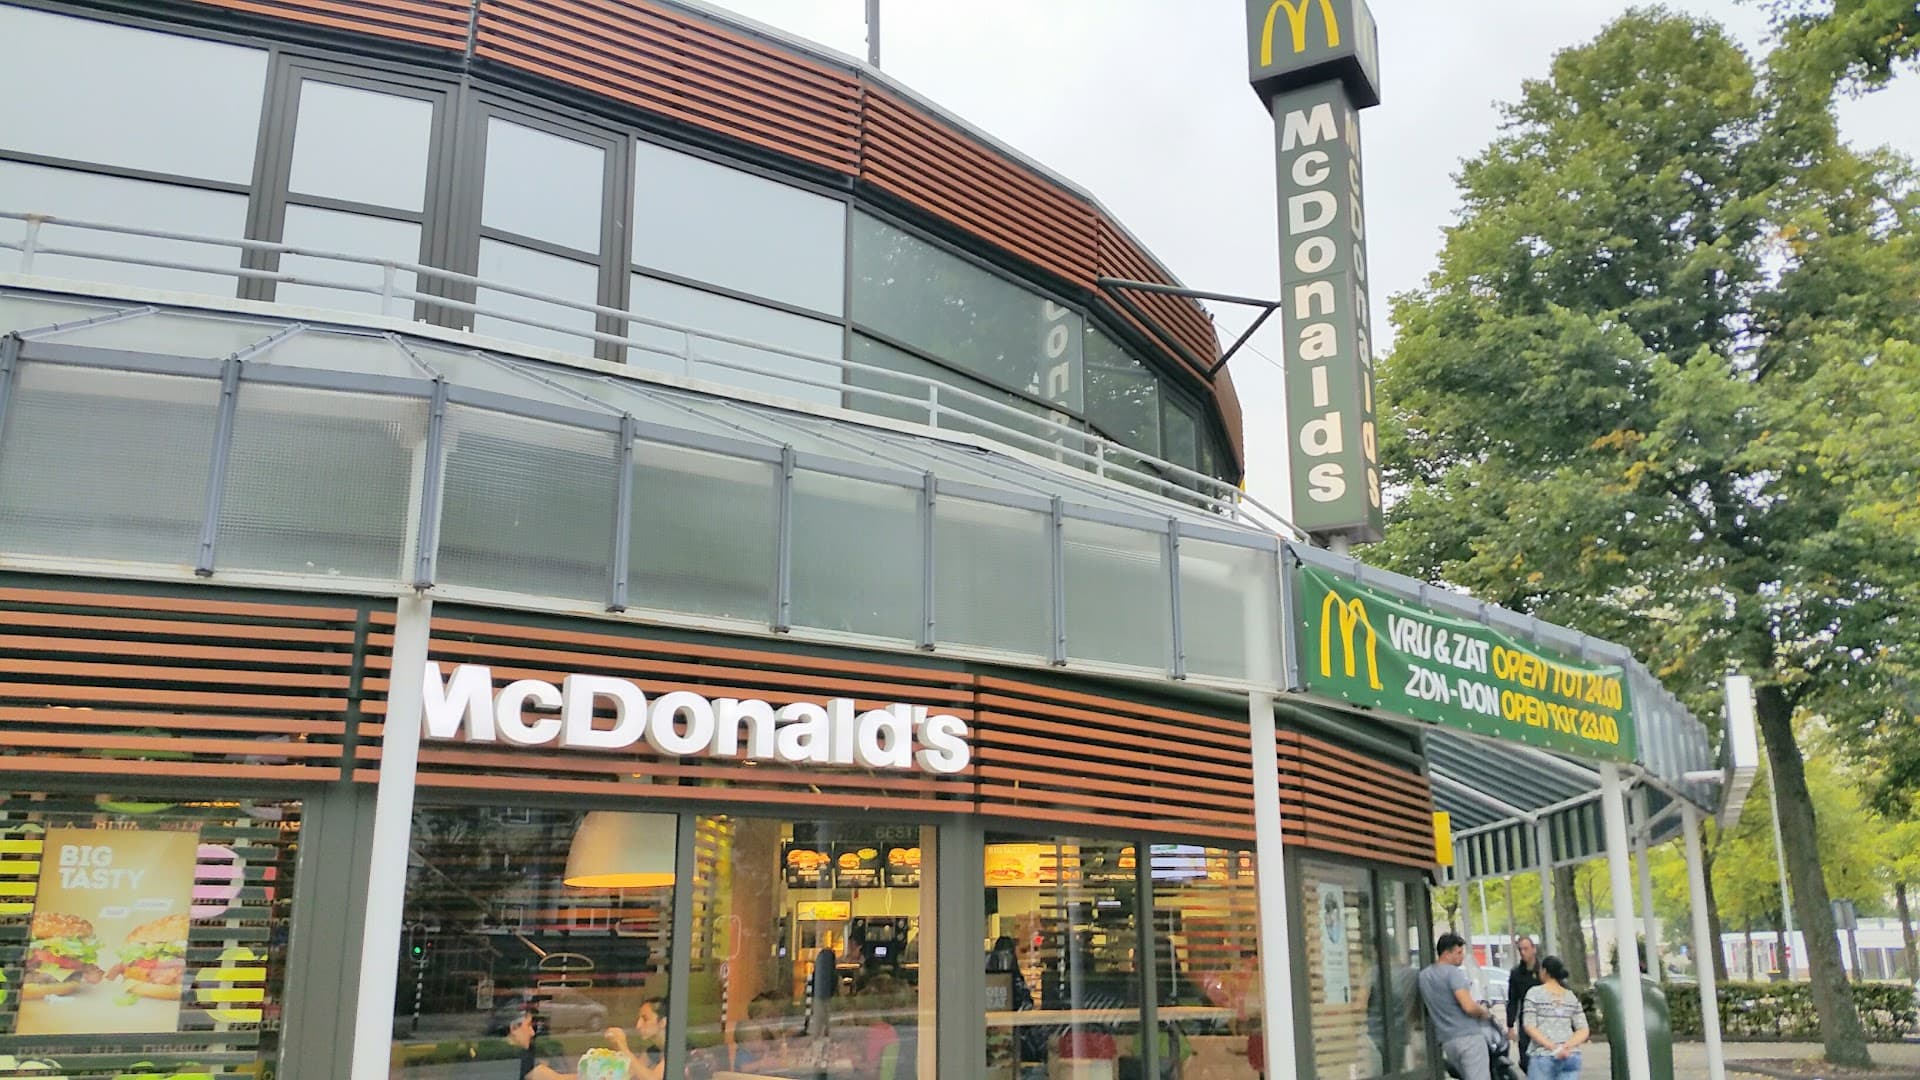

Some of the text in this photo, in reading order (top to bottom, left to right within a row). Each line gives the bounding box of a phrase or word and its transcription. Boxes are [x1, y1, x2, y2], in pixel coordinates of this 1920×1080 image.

[1281, 102, 1346, 503] McDonalds
[1434, 628, 1451, 665] &
[1452, 633, 1490, 674] ZAT
[1492, 645, 1547, 691] OPEN
[1548, 663, 1585, 700] TOT
[1584, 673, 1622, 710] 24.00
[421, 661, 972, 774] McDonald's
[1501, 690, 1549, 729] OPEN
[1548, 702, 1579, 736] TOT
[1579, 710, 1619, 745] 23.00
[59, 845, 112, 867] BIG
[59, 867, 144, 889] TASTY
